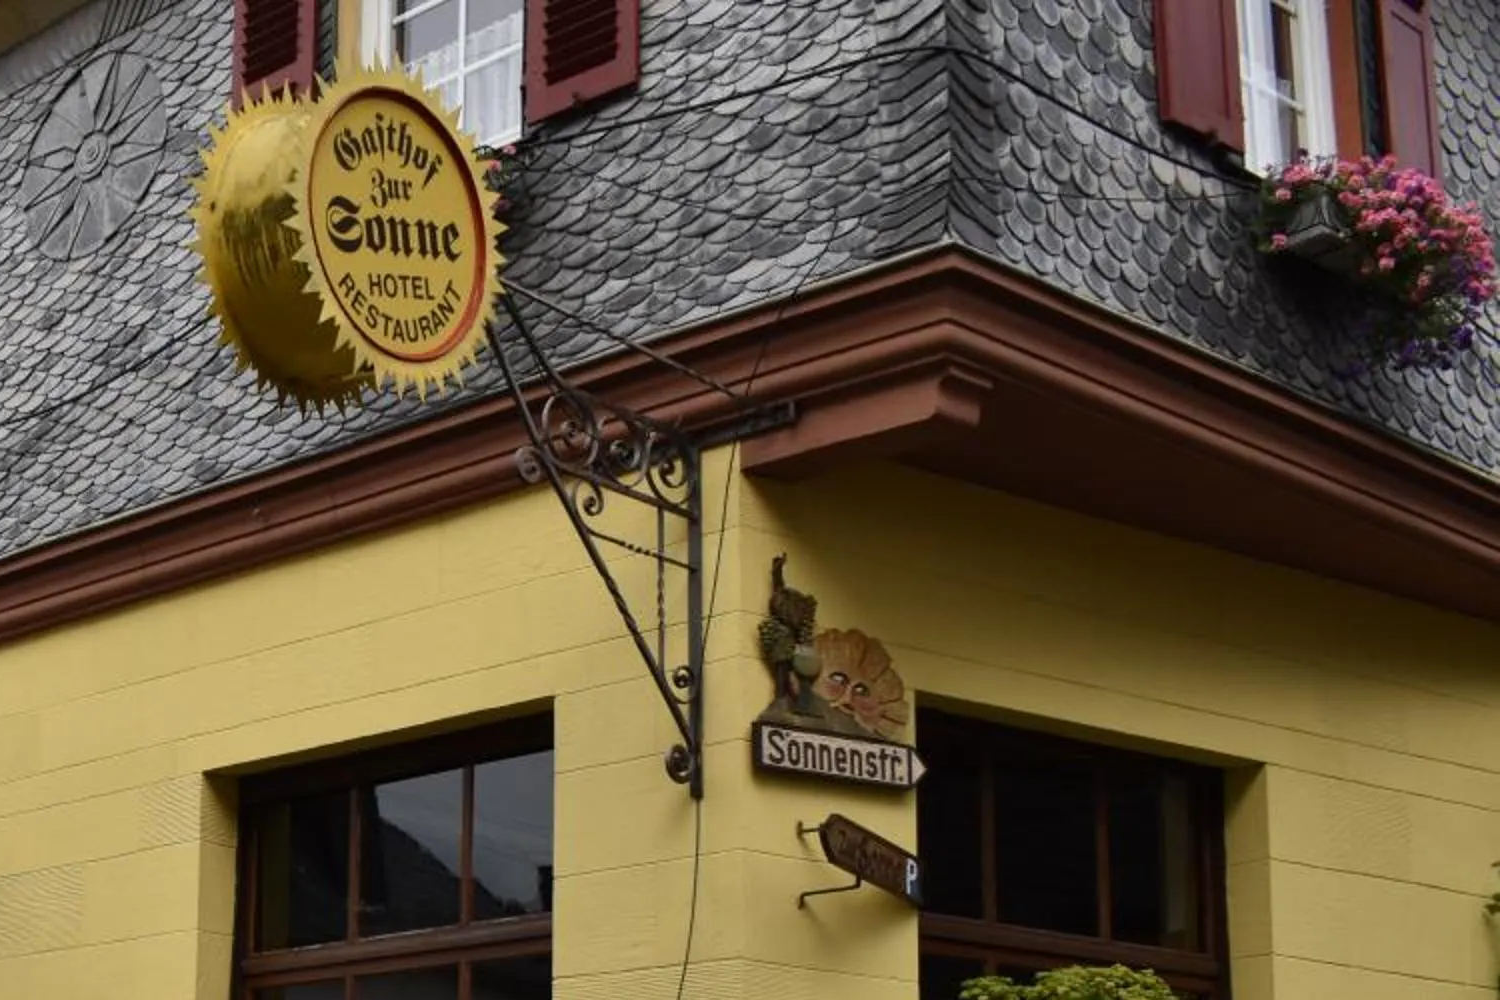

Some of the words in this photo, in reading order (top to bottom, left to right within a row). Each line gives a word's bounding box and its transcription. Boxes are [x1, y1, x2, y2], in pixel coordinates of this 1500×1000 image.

[325, 194, 462, 263] Sonne
[337, 271, 462, 343] RESTAURANT
[367, 273, 435, 301] HOTEL
[767, 729, 904, 784] Sonnenstr.
[905, 857, 919, 896] P
